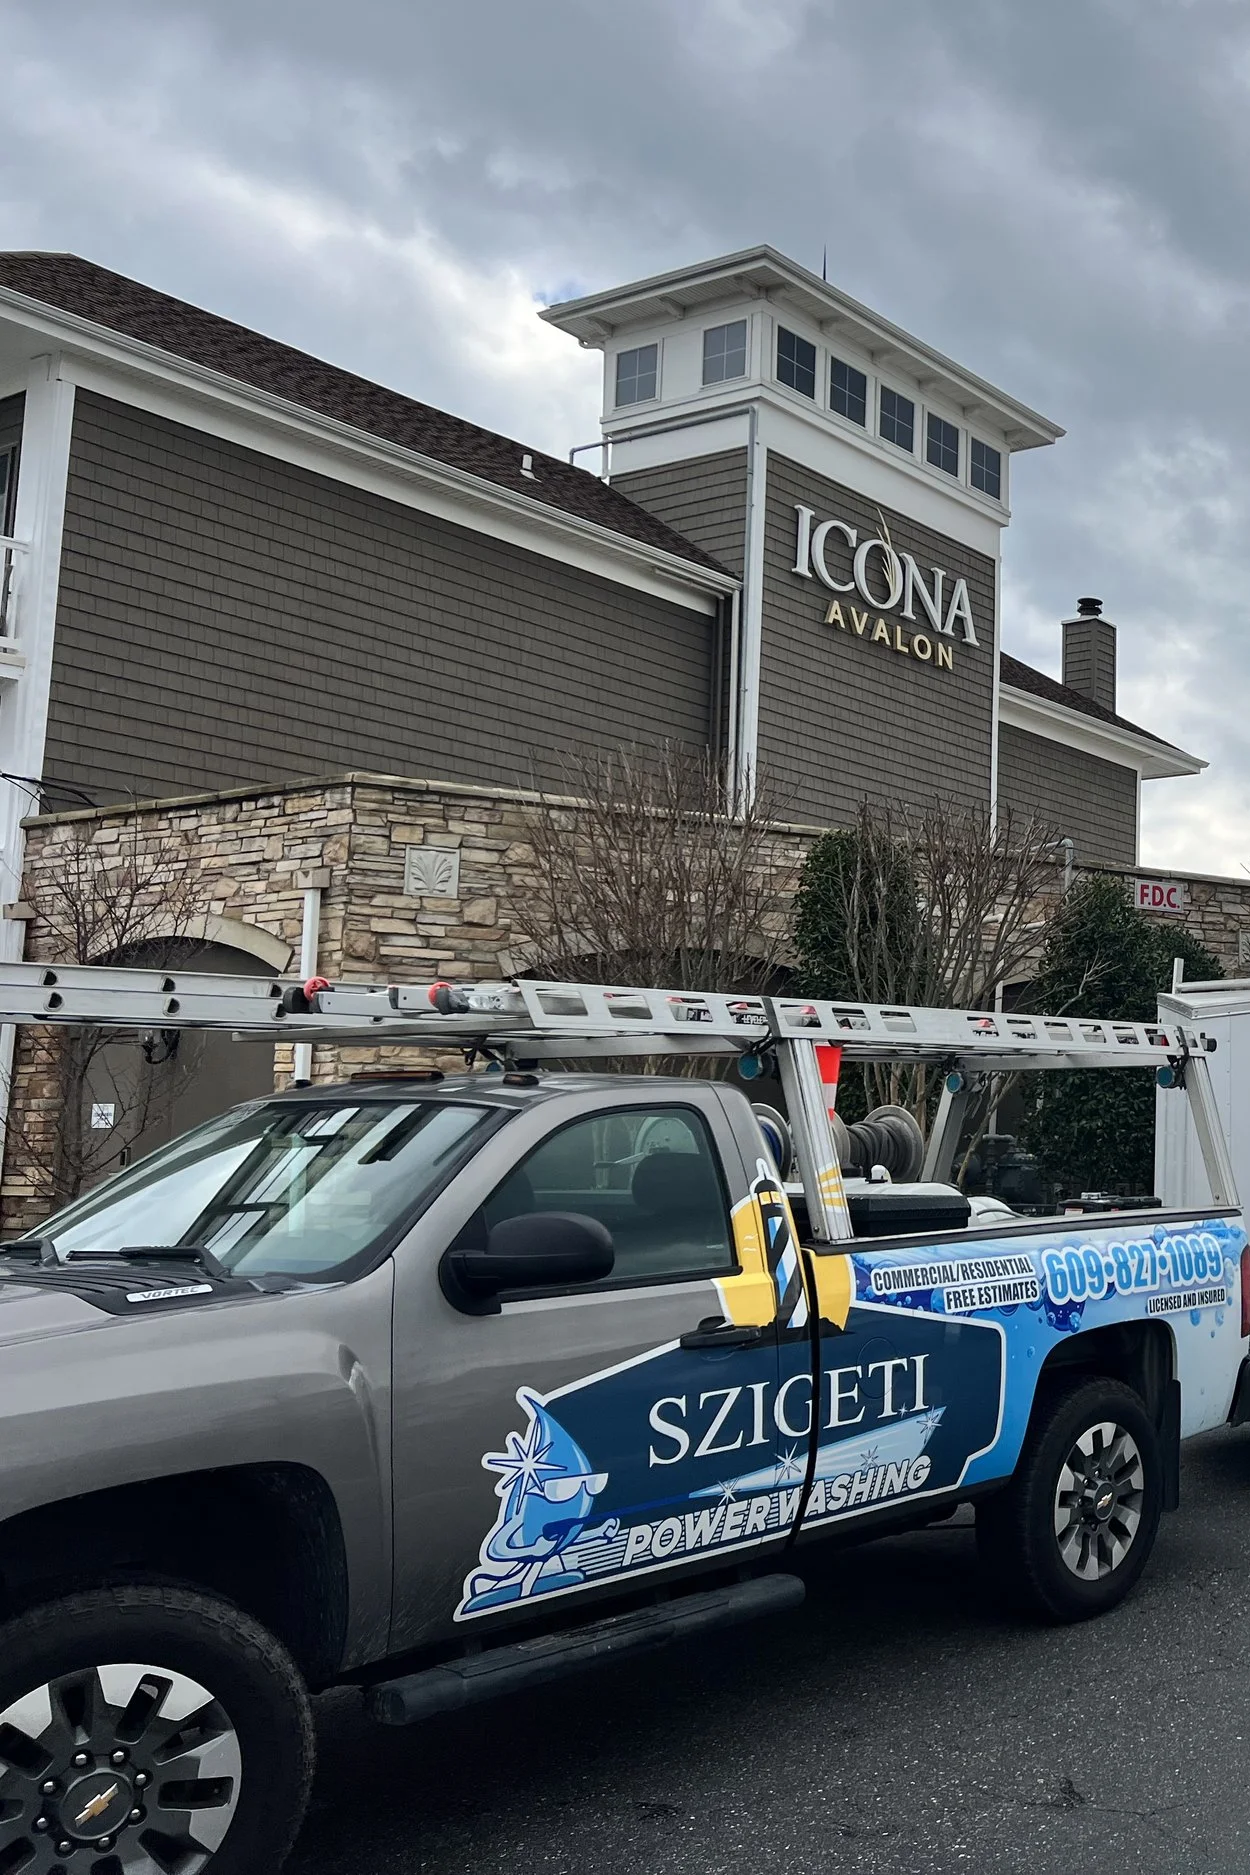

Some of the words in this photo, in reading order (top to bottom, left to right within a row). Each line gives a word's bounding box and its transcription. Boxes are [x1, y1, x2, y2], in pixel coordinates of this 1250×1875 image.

[791, 505, 980, 646] ICONA
[824, 600, 953, 670] AVALON
[1140, 884, 1180, 908] F.D.C.
[140, 1286, 200, 1299] VORTEC
[873, 1259, 1033, 1291] COMMERCIAL/RESIDENTIAL
[946, 1288, 976, 1310] FREE
[978, 1281, 1037, 1304] ESTIMATES
[1149, 1296, 1182, 1313] LICENSED
[1182, 1293, 1197, 1308] AND
[1197, 1289, 1226, 1305] INSURED
[649, 1354, 929, 1468] SZIGETI
[622, 1494, 771, 1566] POWER
[779, 1455, 932, 1527] WASHING
